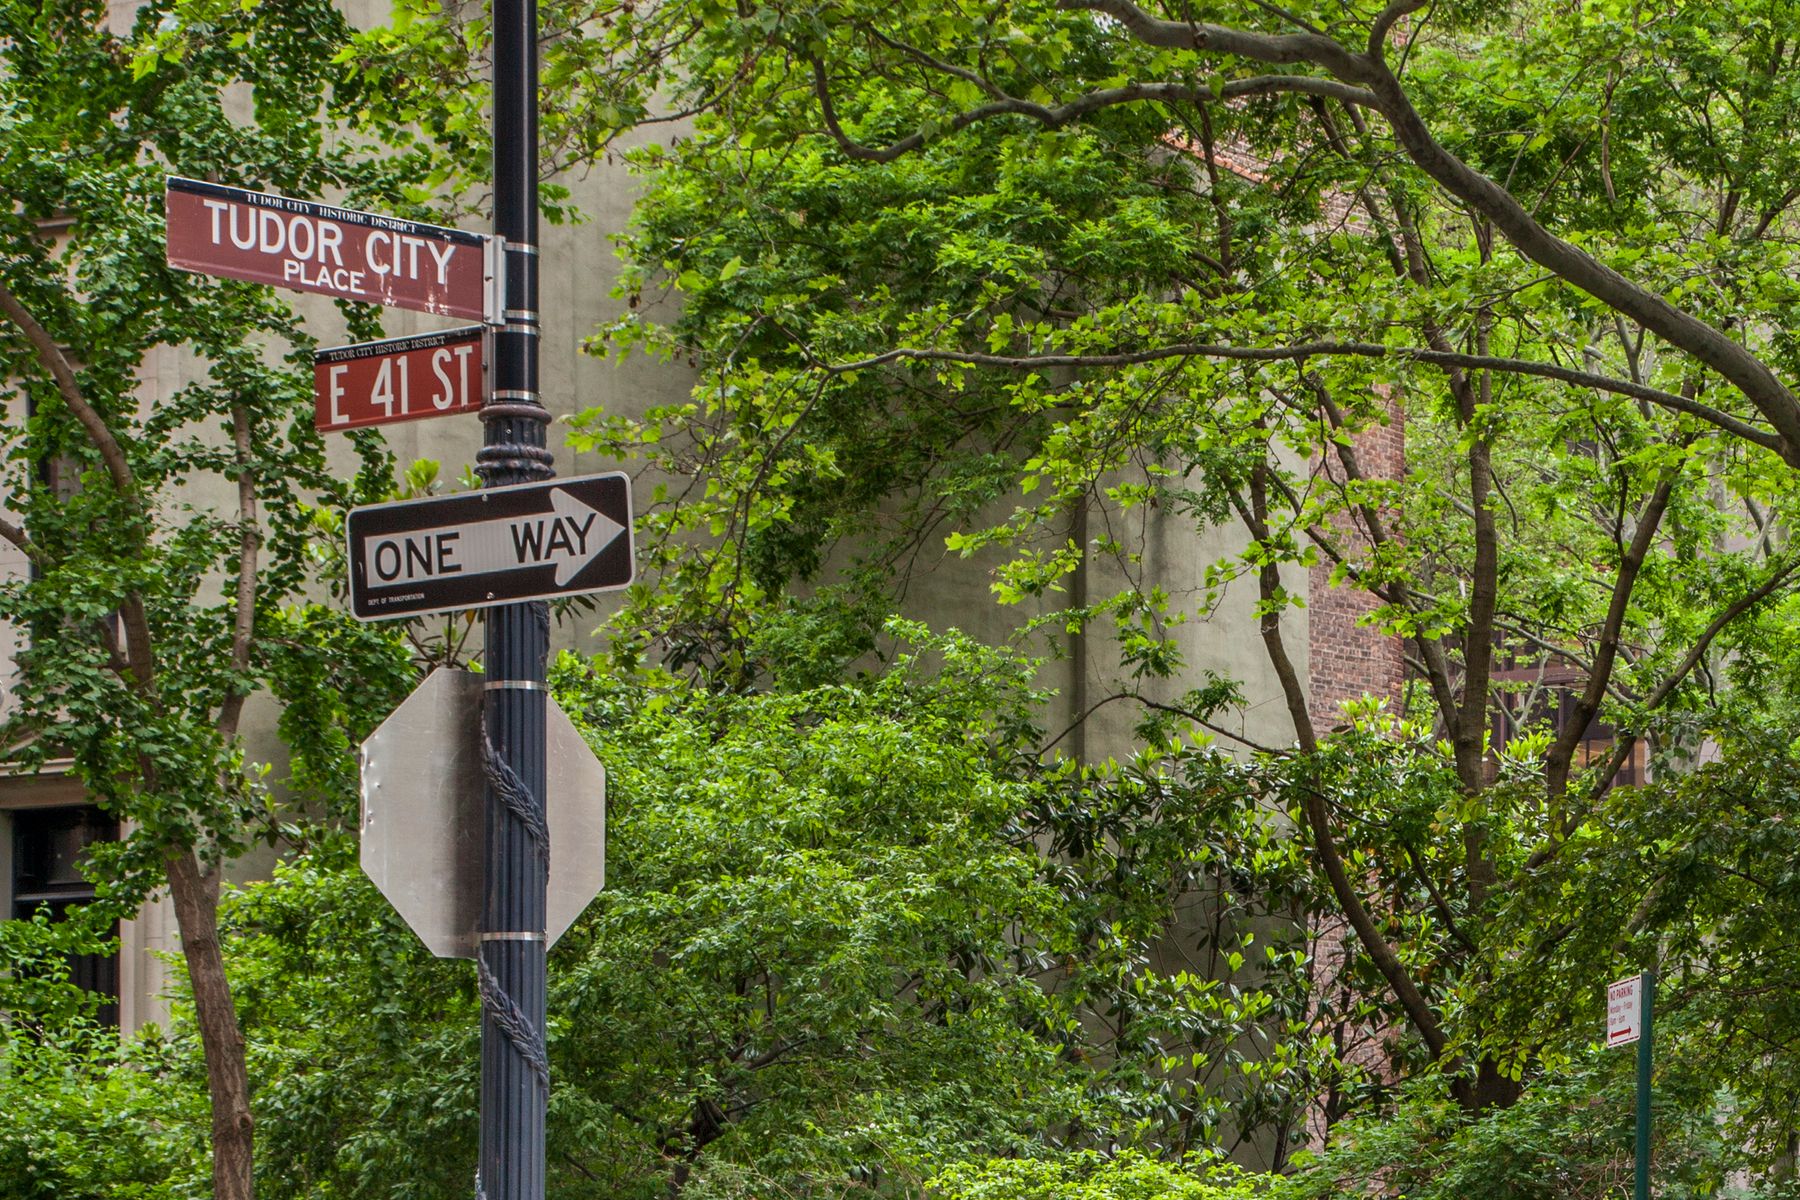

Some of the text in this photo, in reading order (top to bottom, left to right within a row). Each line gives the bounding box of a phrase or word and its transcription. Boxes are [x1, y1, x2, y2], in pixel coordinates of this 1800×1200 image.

[246, 193, 418, 234] TUDOR CITY HISTORIC DISTRICT
[203, 199, 456, 285] TUDOR CITY
[284, 259, 365, 295] PLACE
[329, 335, 446, 361] TUDOR CITY HISTORIC DISTRICT
[329, 345, 473, 425] E 41 ST
[374, 512, 597, 581] ONE WAY
[1616, 985, 1632, 998] PARKING
